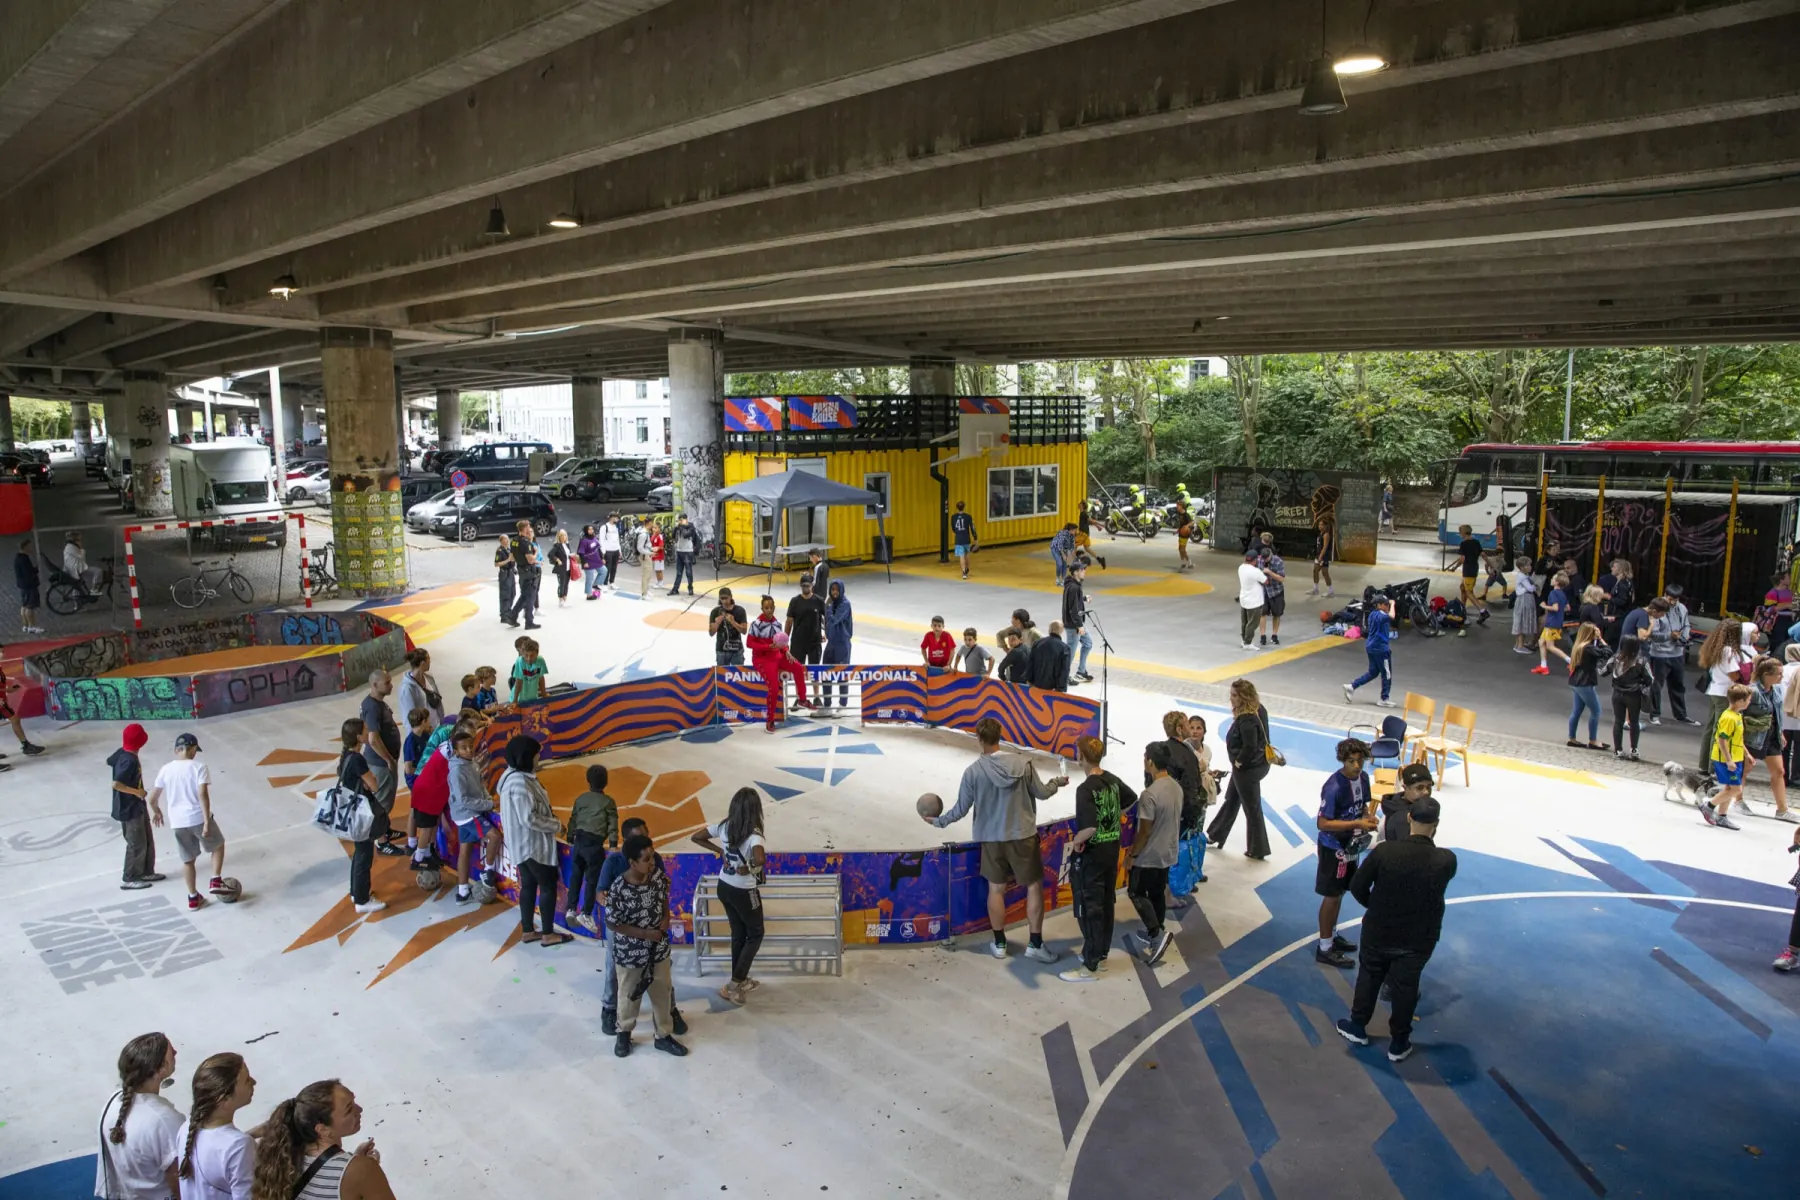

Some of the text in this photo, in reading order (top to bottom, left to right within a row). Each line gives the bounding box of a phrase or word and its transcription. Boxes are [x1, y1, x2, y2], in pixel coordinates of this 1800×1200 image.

[813, 401, 840, 413] PANNA
[811, 412, 839, 424] HOUSE
[1275, 505, 1308, 518] STREET
[955, 518, 966, 531] 41
[281, 614, 344, 645] CPH
[725, 671, 765, 682] PANN
[818, 670, 917, 682] INVITATIONALS
[228, 669, 290, 704] CPH
